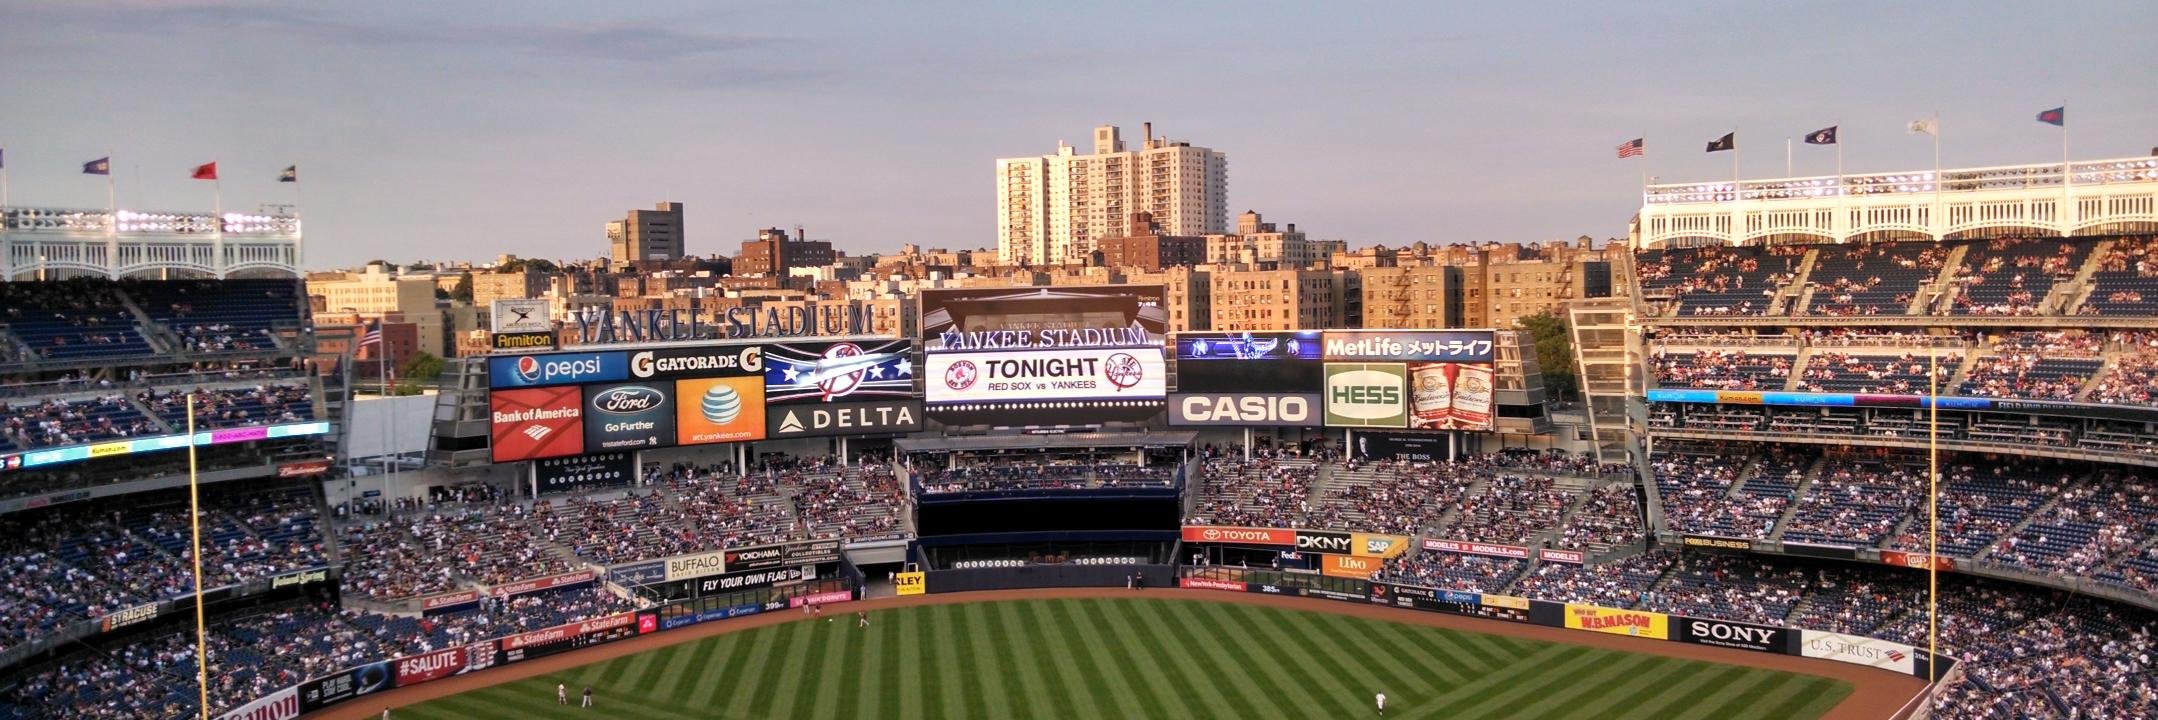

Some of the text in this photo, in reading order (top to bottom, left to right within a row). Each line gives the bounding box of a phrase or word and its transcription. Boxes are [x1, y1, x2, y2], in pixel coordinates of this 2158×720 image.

[572, 304, 875, 344] YANKEE STADIUM
[498, 334, 551, 347] Armitron
[939, 327, 1150, 351] YANKEE STADIUM
[1326, 337, 1491, 356] MetLife メットライフ
[545, 356, 601, 381] pepsi
[656, 354, 738, 371] GATORADE
[985, 358, 1098, 379] TONIGHT
[988, 383, 1008, 391] RED
[1010, 382, 1032, 391] SOX
[1051, 380, 1097, 389] YANKEES
[607, 391, 650, 411] Ford
[1332, 385, 1398, 405] HESS
[494, 407, 579, 423] Bank of America
[1182, 396, 1308, 421] CASIO
[605, 421, 654, 432] Go Further
[813, 407, 915, 429] DELTA
[602, 439, 646, 448] tristateford.com
[1222, 530, 1270, 541] TOYOTA
[1296, 535, 1350, 551] DKNY
[1368, 540, 1388, 552] SAP
[1425, 540, 1525, 556] MODELL'S MODELLS.com
[738, 549, 780, 561] YOKOHAMA
[1281, 551, 1303, 560] FedEx
[1543, 552, 1580, 561] MODELL'S
[671, 556, 719, 572] BUFFALO
[702, 569, 787, 592] FLY YOUR OWN FLAG
[1454, 593, 1473, 601] pepsi
[111, 604, 158, 625] SYRACUSE
[1691, 621, 1776, 644] SONY
[1838, 643, 1882, 660] TRUST
[400, 651, 457, 676] #SALUTE
